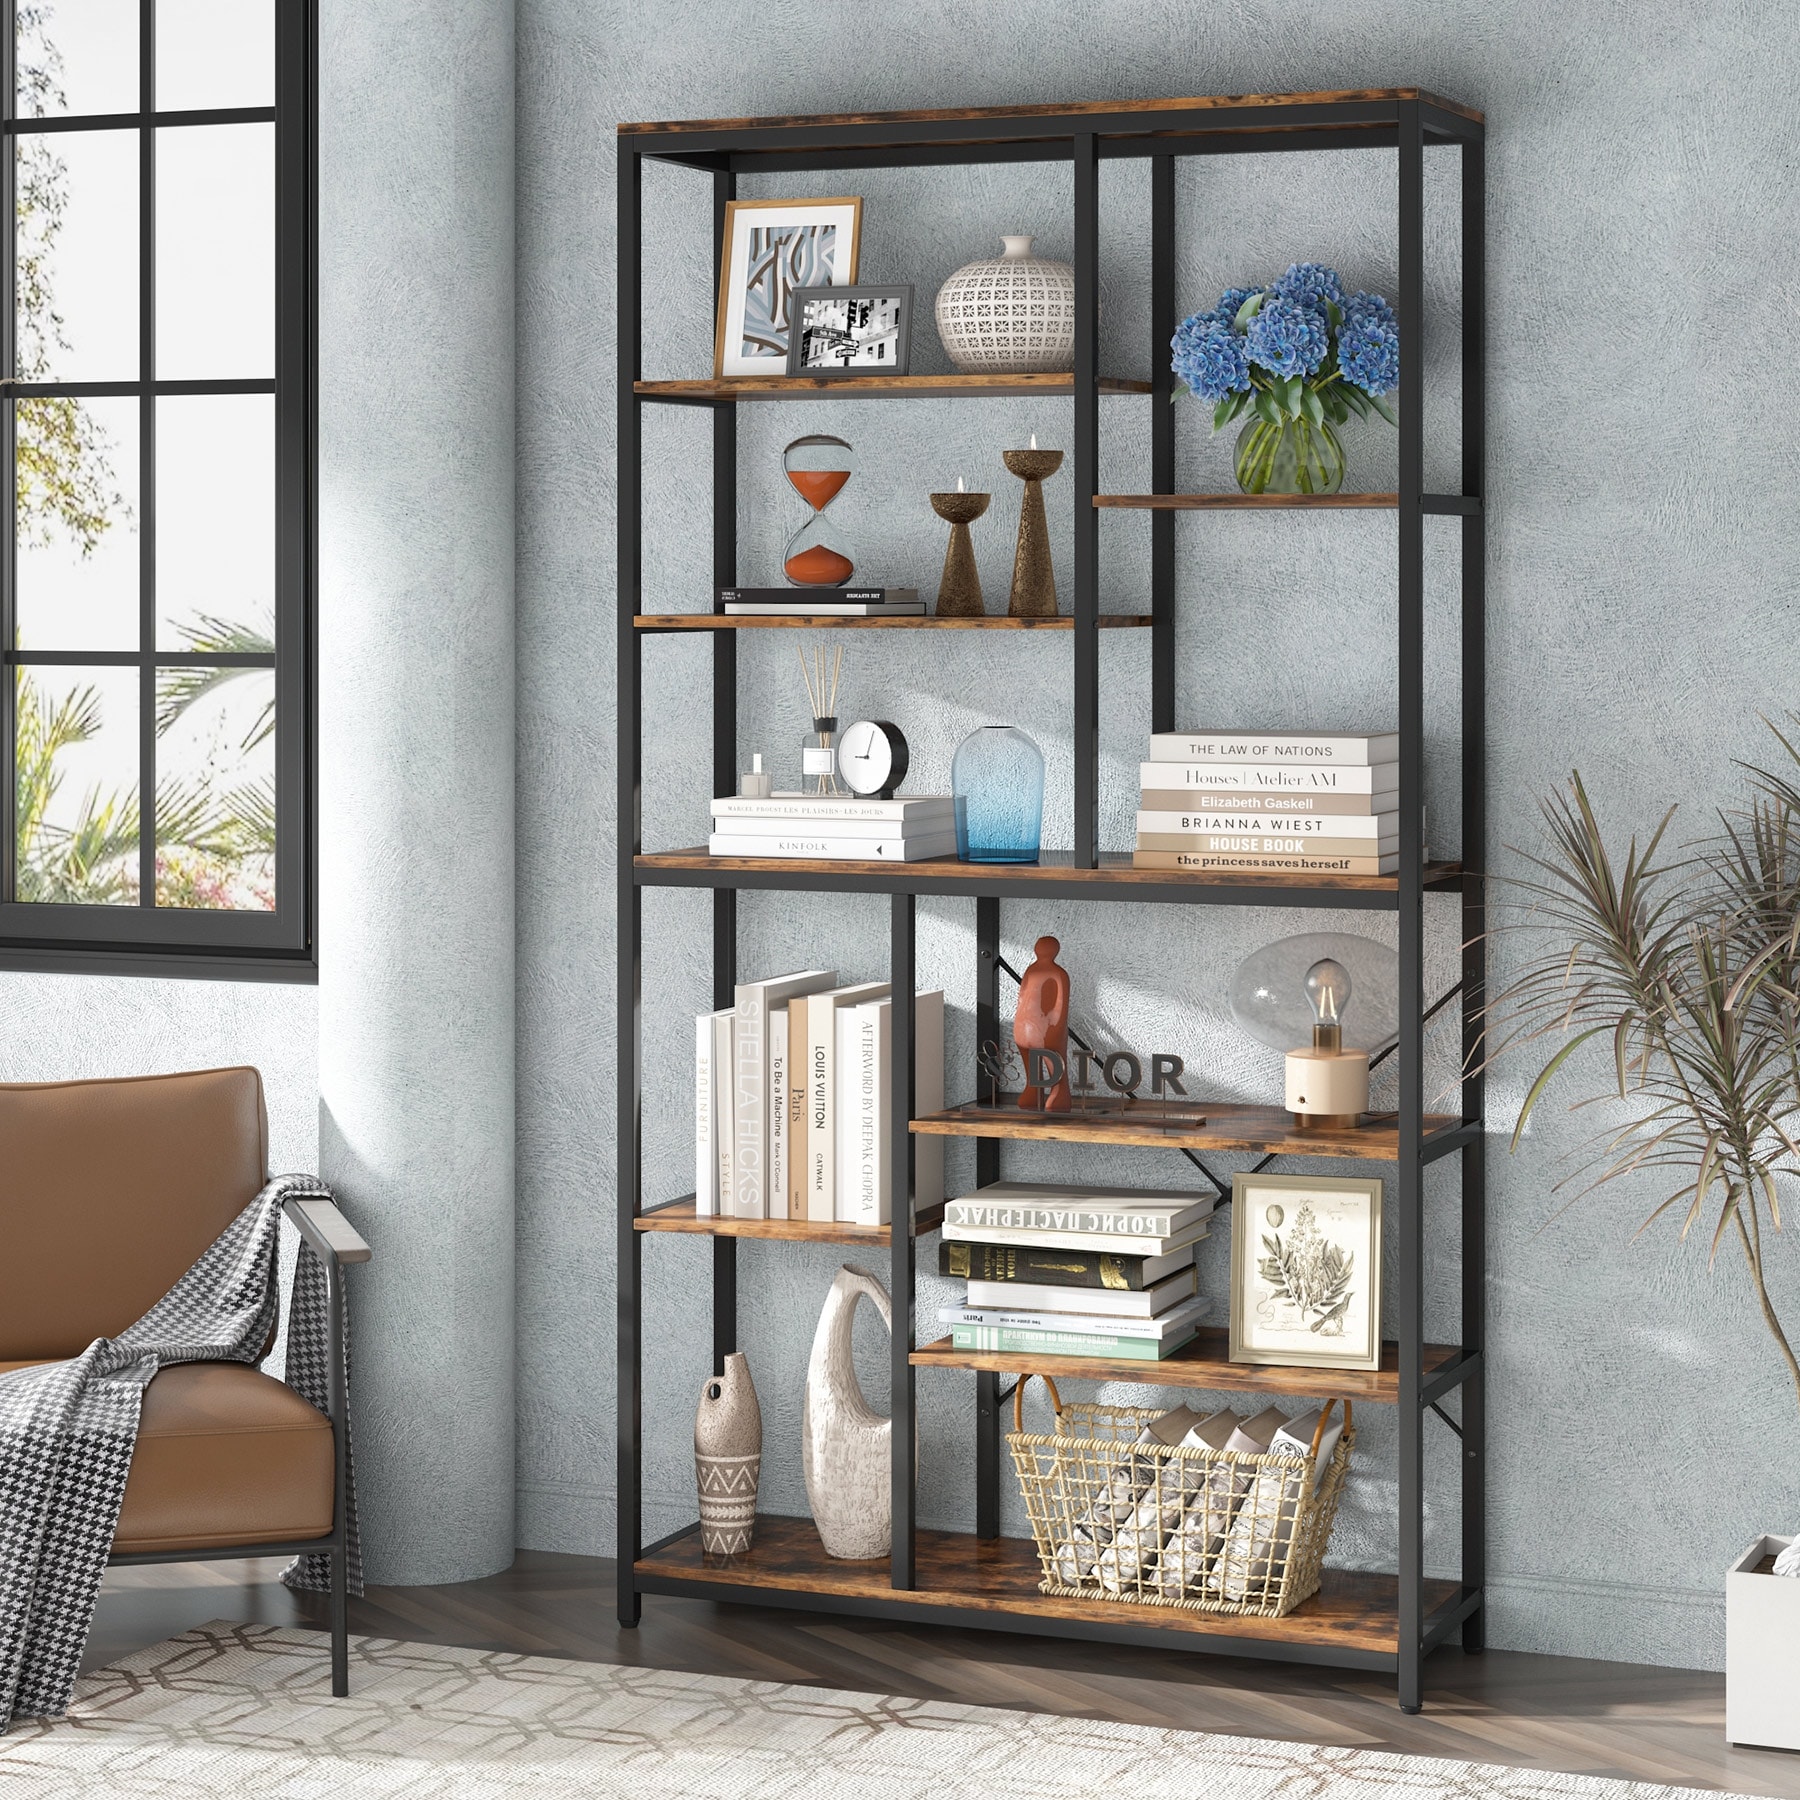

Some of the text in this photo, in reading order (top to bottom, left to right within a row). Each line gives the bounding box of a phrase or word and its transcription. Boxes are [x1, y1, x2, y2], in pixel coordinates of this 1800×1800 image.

[1189, 744, 1333, 757] THE LAW OF NATIONS
[1186, 770, 1239, 785] Houses
[1251, 771, 1302, 786] Atelier
[1307, 773, 1336, 787] AM
[1201, 796, 1313, 810] Elizabeth Gaskell
[1181, 817, 1323, 831] BRIANNA WIEST
[779, 842, 828, 851] KINFOLK
[1209, 837, 1305, 852] HOUSE BOOK
[1177, 856, 1200, 866] the
[1301, 859, 1351, 870] herself
[774, 1057, 783, 1070] To
[1028, 1048, 1188, 1096] DIOR
[774, 1071, 783, 1085] Be
[815, 1045, 825, 1129] LOUIS VUITTON
[699, 1057, 709, 1142] FURNITURE
[774, 1087, 781, 1095] a
[792, 1088, 805, 1122] Paris
[861, 1021, 874, 1211] AFTERWORD BY DEEPAK CHOPRA
[773, 1096, 783, 1137] Machine
[739, 1119, 759, 1204] HICKS
[816, 1153, 824, 1191] CATWALK
[721, 1153, 731, 1196] STYLE
[955, 1207, 1157, 1234] БОРИС ПАСТЕРНАК
